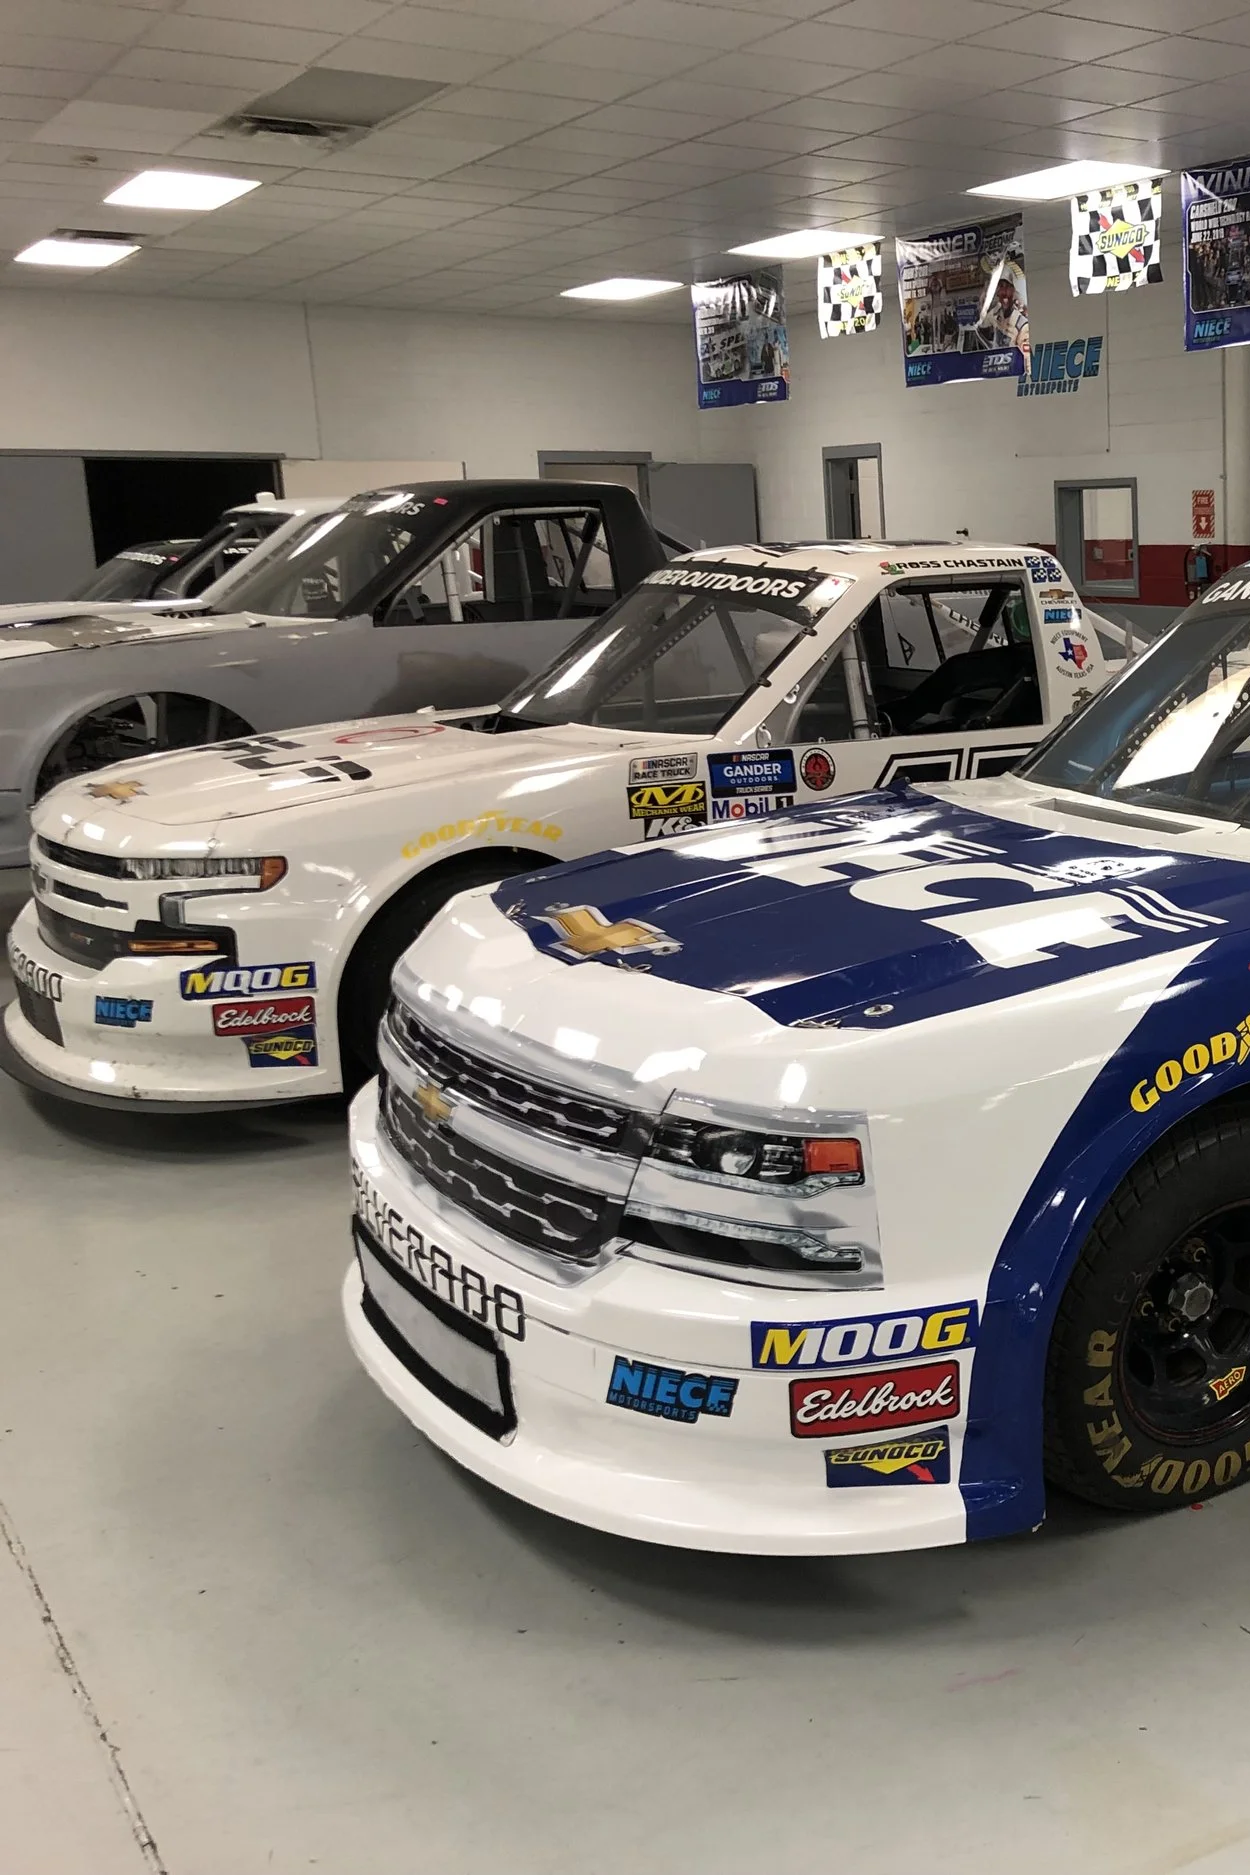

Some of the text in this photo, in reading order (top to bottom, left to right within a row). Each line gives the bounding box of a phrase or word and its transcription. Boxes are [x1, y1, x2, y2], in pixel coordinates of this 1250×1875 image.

[1099, 227, 1143, 250] SUNOCO
[1194, 318, 1231, 338] NIECE
[908, 361, 932, 377] NIECE
[1018, 336, 1104, 384] NIECE
[1016, 379, 1079, 397] MOTORSPORTS
[898, 558, 1024, 570] ROSS CHASTAIN
[650, 757, 688, 769] NASCAR
[741, 753, 770, 762] NASCAR
[634, 767, 691, 780] RACE TRUCK
[723, 763, 782, 778] GANDER
[730, 775, 778, 785] OUTDOORS
[632, 802, 705, 818] MECHANIX WEAR
[712, 799, 769, 820] Mobil
[96, 996, 153, 1022] NIECE
[218, 1005, 313, 1029] Edelbrock
[253, 1040, 313, 1053] SUNOCO
[351, 1156, 526, 1342] SILVERADO
[758, 1307, 971, 1365] MOOG
[611, 1359, 737, 1414] NIECE
[1218, 1370, 1242, 1394] AERO
[609, 1391, 698, 1422] MOTORSPORTS
[796, 1375, 956, 1424] Edelbrock
[833, 1441, 943, 1464] SUNOCO
